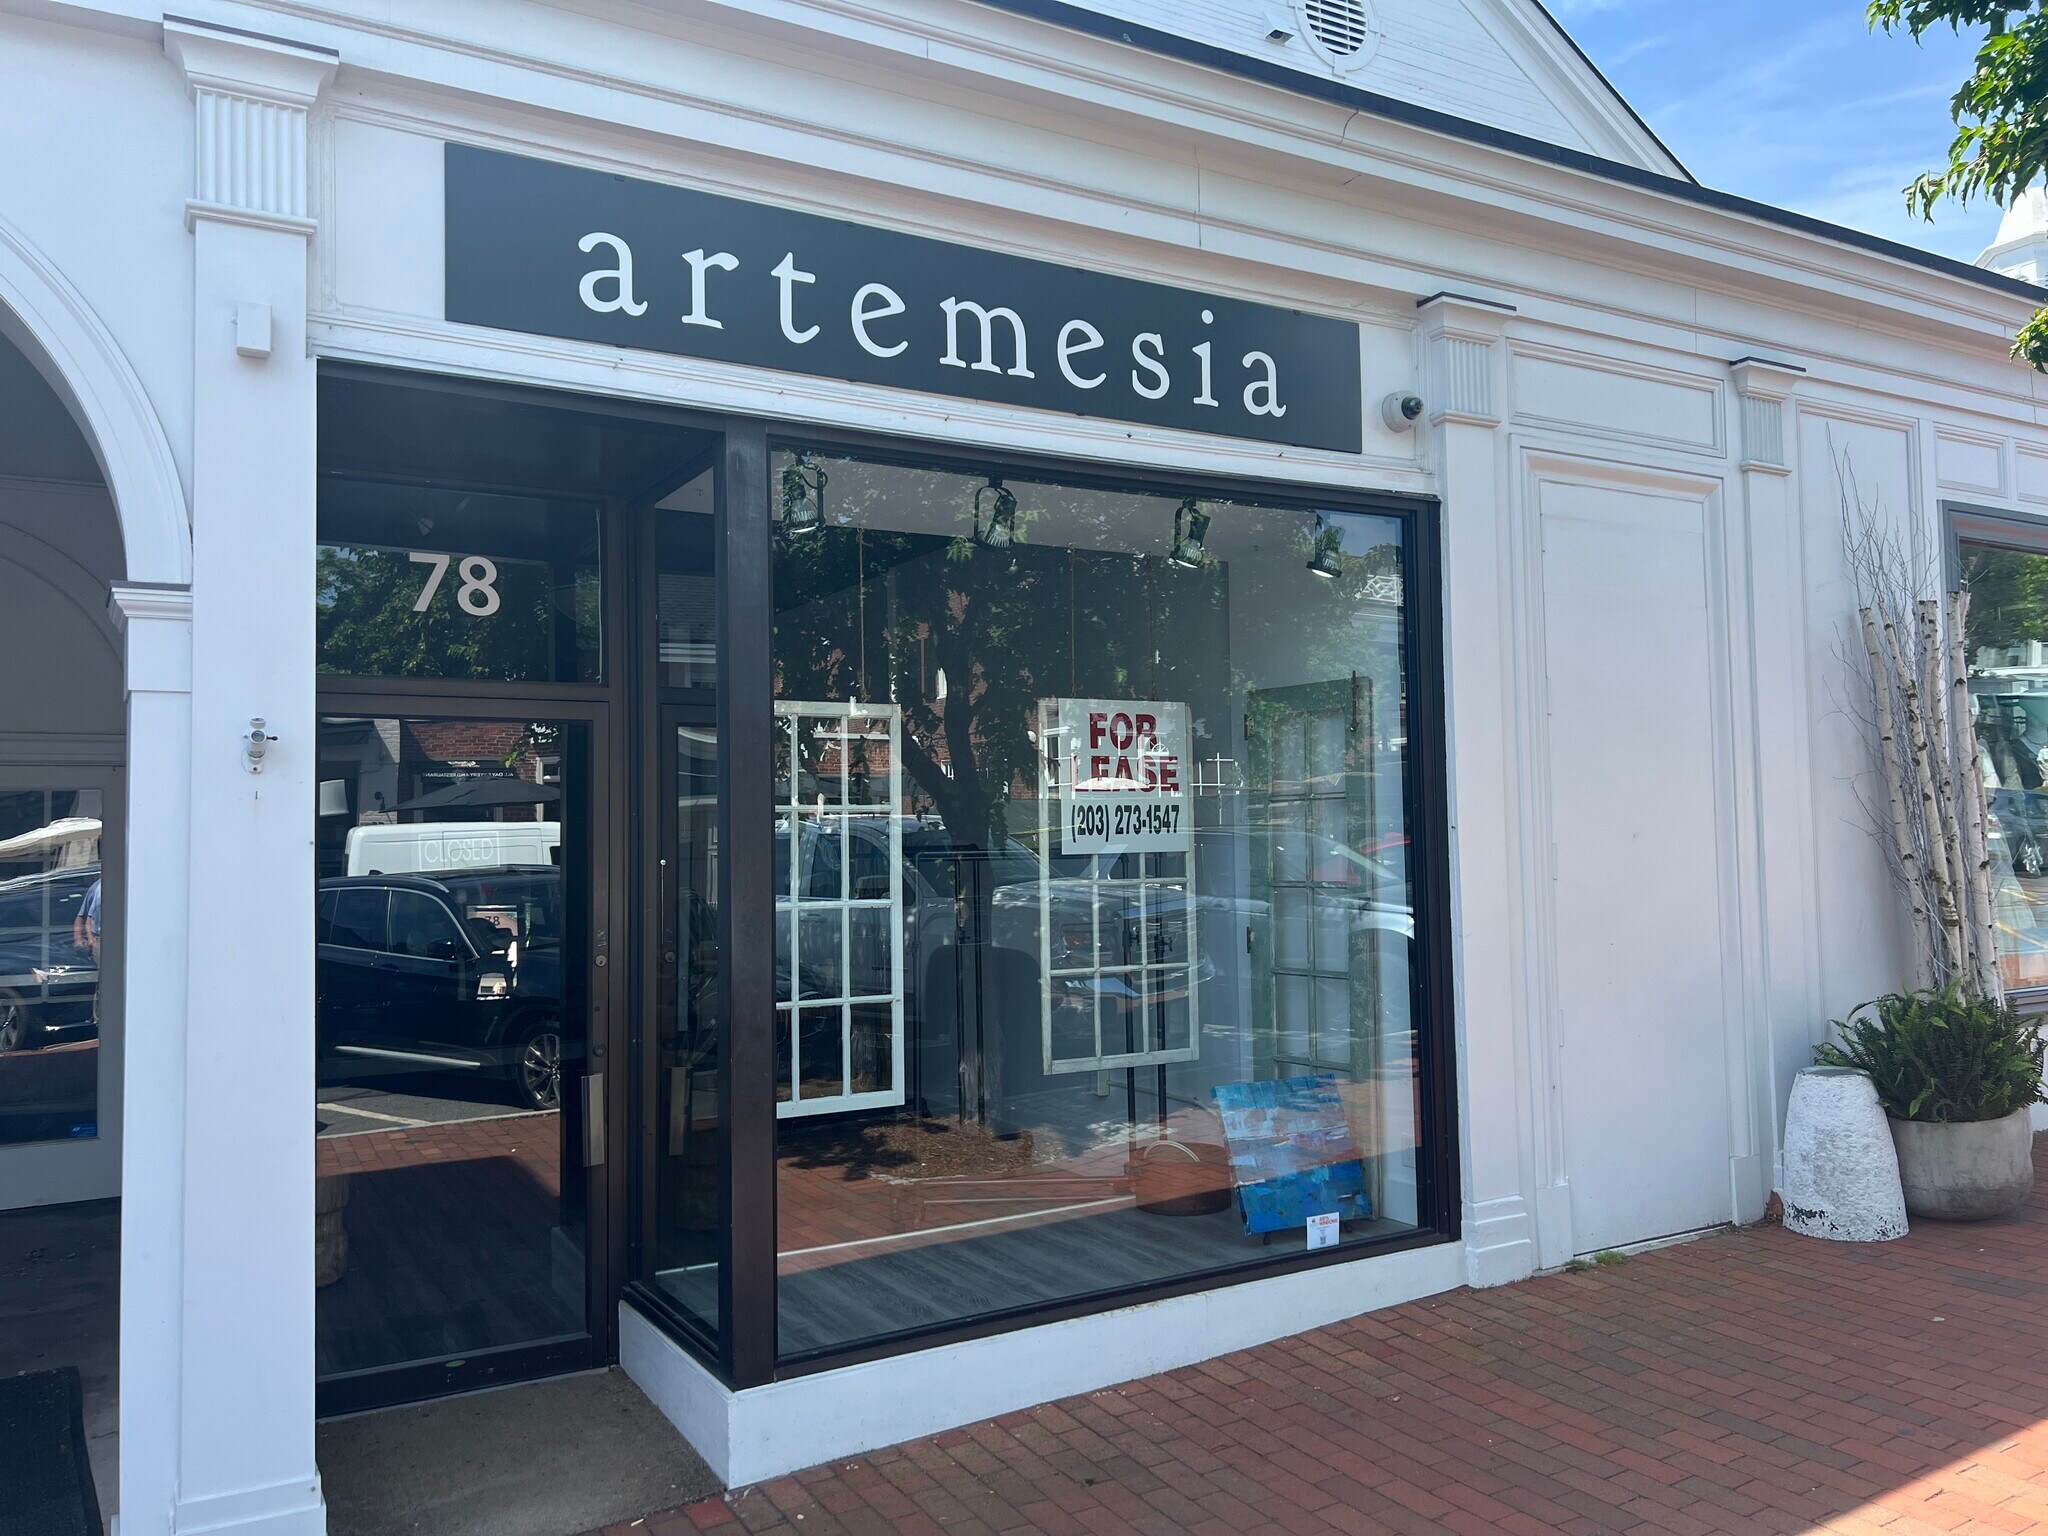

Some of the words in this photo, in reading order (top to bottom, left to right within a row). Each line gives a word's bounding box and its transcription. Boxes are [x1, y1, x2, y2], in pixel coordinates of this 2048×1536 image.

[577, 231, 1287, 418] artemesia
[408, 551, 501, 617] 78
[1088, 712, 1158, 751] FOR
[1071, 755, 1180, 793] LEASE
[1071, 804, 1110, 843] (203)
[1114, 804, 1180, 835] 273-1547
[424, 838, 494, 863] CLOSED
[484, 915, 501, 926] 78
